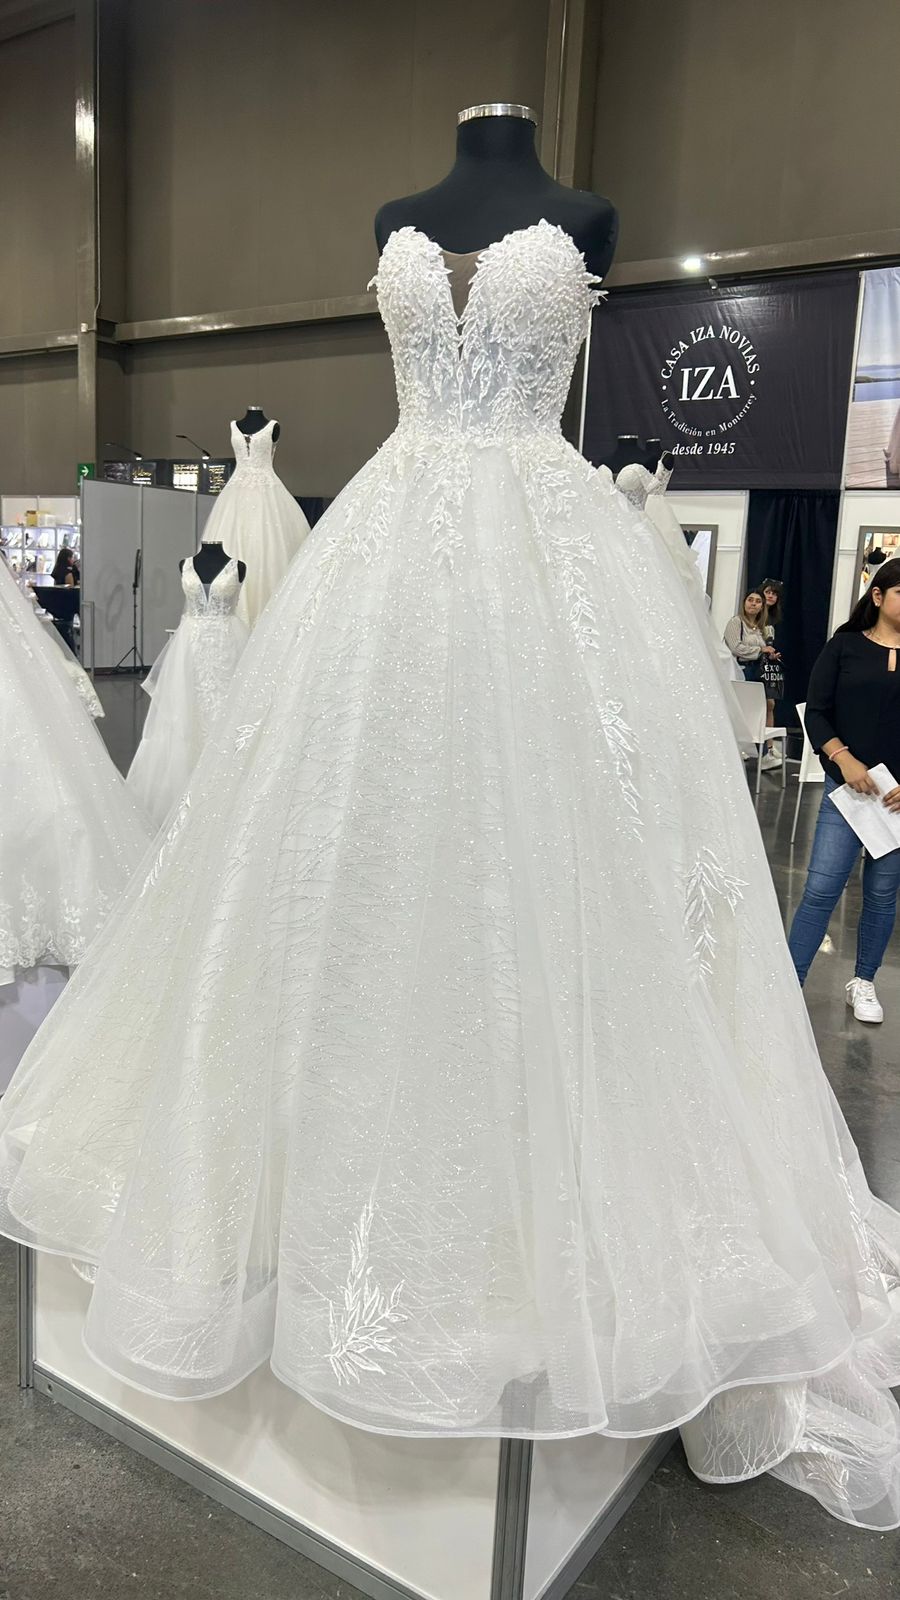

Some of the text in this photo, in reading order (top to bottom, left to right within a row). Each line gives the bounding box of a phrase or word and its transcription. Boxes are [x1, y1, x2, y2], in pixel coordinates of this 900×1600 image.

[660, 325, 760, 379] CASA IZA NOVIAS
[679, 365, 740, 401] IZA
[661, 399, 669, 413] La
[667, 411, 702, 437] Tradición
[719, 393, 757, 433] Monterrey
[672, 442, 736, 456] desde 1945
